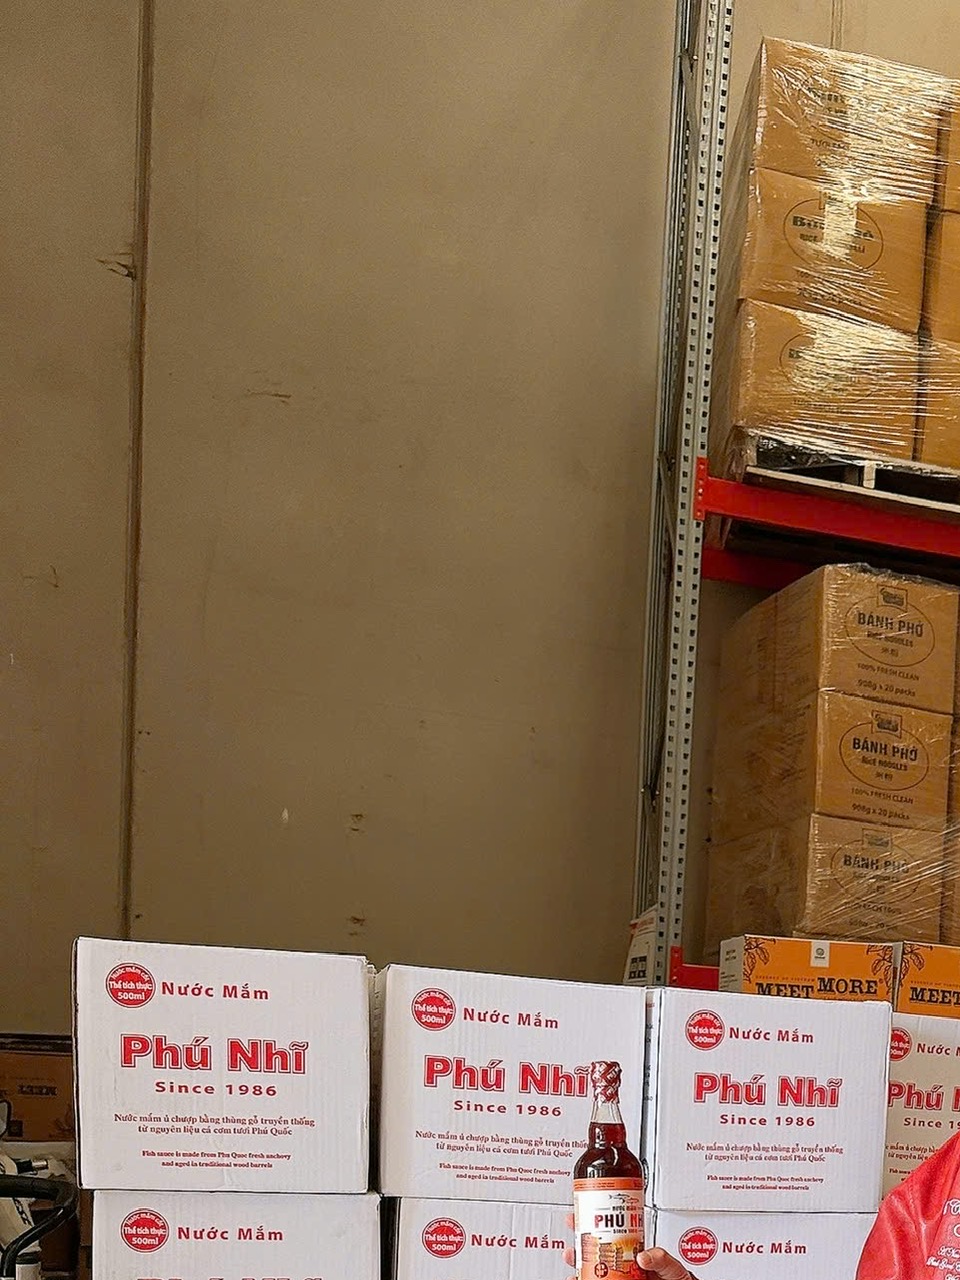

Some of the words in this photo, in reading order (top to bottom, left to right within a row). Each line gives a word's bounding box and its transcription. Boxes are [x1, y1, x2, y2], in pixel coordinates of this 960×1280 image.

[852, 736, 888, 756] BÁNH
[892, 745, 919, 762] PHỞ
[159, 980, 215, 999] Nước
[221, 983, 272, 1001] Mắm
[756, 981, 814, 999] MEET
[817, 977, 878, 996] MORE
[462, 1006, 509, 1024] Nước
[516, 1012, 560, 1029] Mắm
[725, 1026, 773, 1041] Nước
[776, 1028, 814, 1043] Mắm
[119, 1031, 213, 1072] Phú
[225, 1037, 309, 1075] Nhĩ
[915, 1041, 953, 1057] Nước
[423, 1054, 507, 1093] Phú
[518, 1061, 589, 1098] Nhĩ
[154, 1078, 216, 1095] Since
[225, 1083, 278, 1098] 1986
[693, 1072, 767, 1107] Phú
[777, 1075, 843, 1109] Nhĩ
[888, 1082, 946, 1113] Phú
[453, 1100, 507, 1114] Since
[515, 1104, 562, 1117] 1986
[720, 1113, 767, 1126] Since
[774, 1116, 815, 1127] 1986
[902, 1115, 947, 1130] Since
[593, 1212, 624, 1228] PHÚ
[629, 1213, 645, 1227] NH
[175, 1225, 229, 1242] Nước
[235, 1227, 284, 1242] Mắm
[469, 1233, 517, 1248] Nước
[524, 1235, 565, 1249] Mắm
[722, 1241, 764, 1254] Nước
[769, 1241, 807, 1254] Mắm
